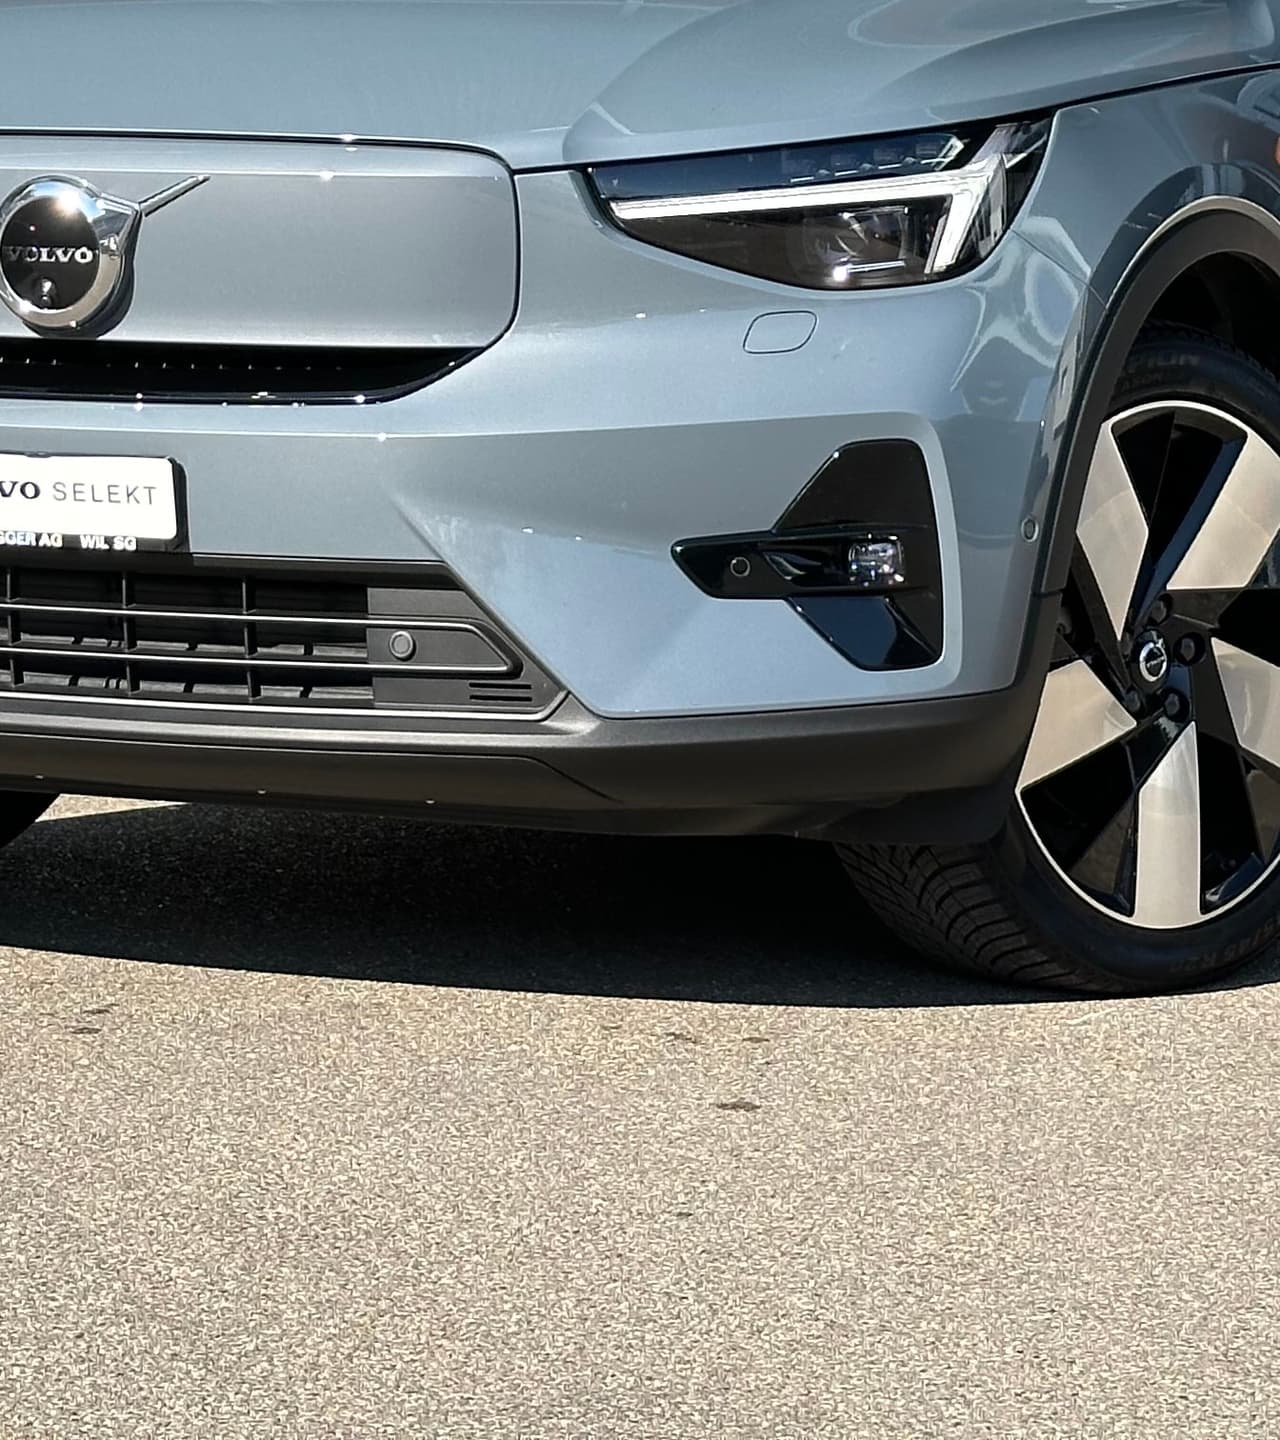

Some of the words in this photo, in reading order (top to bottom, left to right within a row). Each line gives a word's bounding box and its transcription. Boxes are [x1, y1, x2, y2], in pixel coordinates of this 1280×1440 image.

[2, 245, 94, 264] VOLVO
[51, 481, 158, 506] SELEKT
[38, 532, 63, 548] AG
[79, 534, 110, 550] WIL
[113, 535, 137, 551] SG
